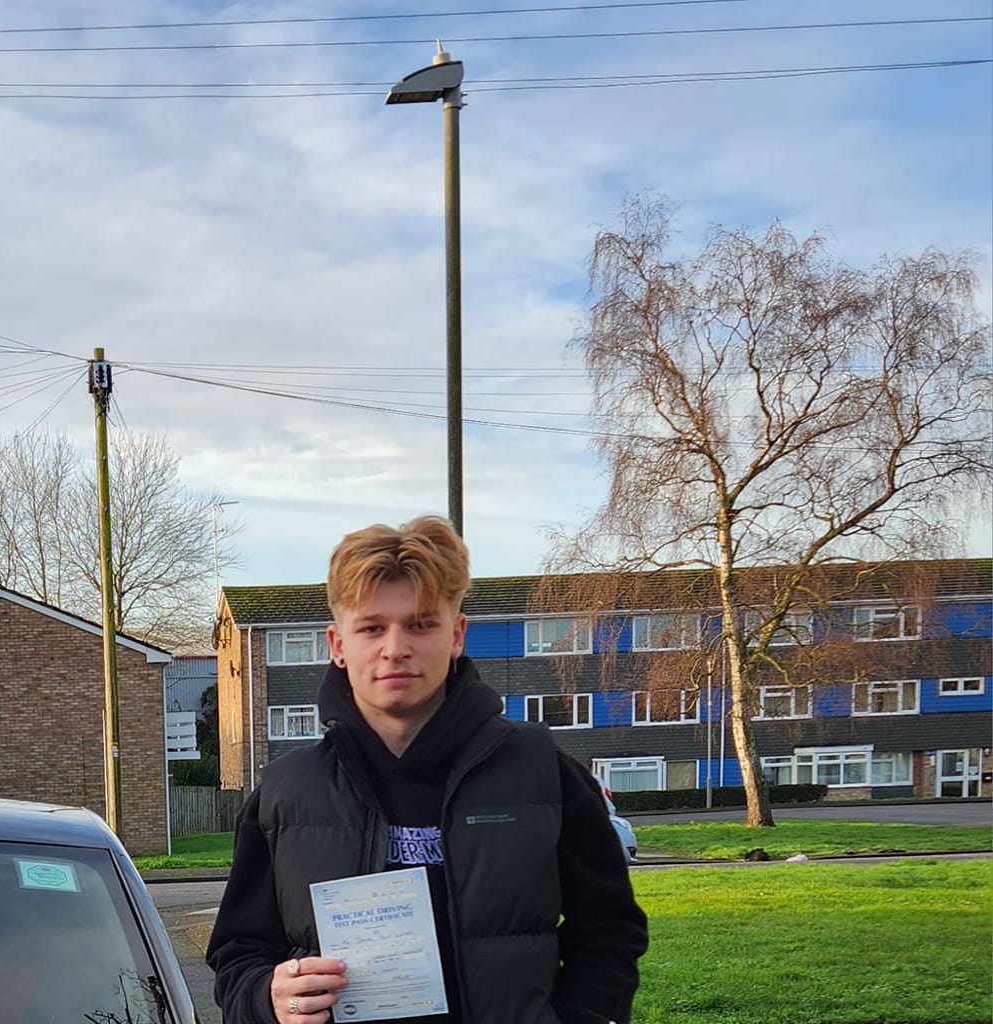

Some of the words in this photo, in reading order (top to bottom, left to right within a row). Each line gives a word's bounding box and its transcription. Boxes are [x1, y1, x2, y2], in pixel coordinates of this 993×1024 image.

[333, 909, 374, 921] PRACTICAL
[377, 904, 413, 914] DRIVING
[370, 911, 413, 922] CERTIFICATE
